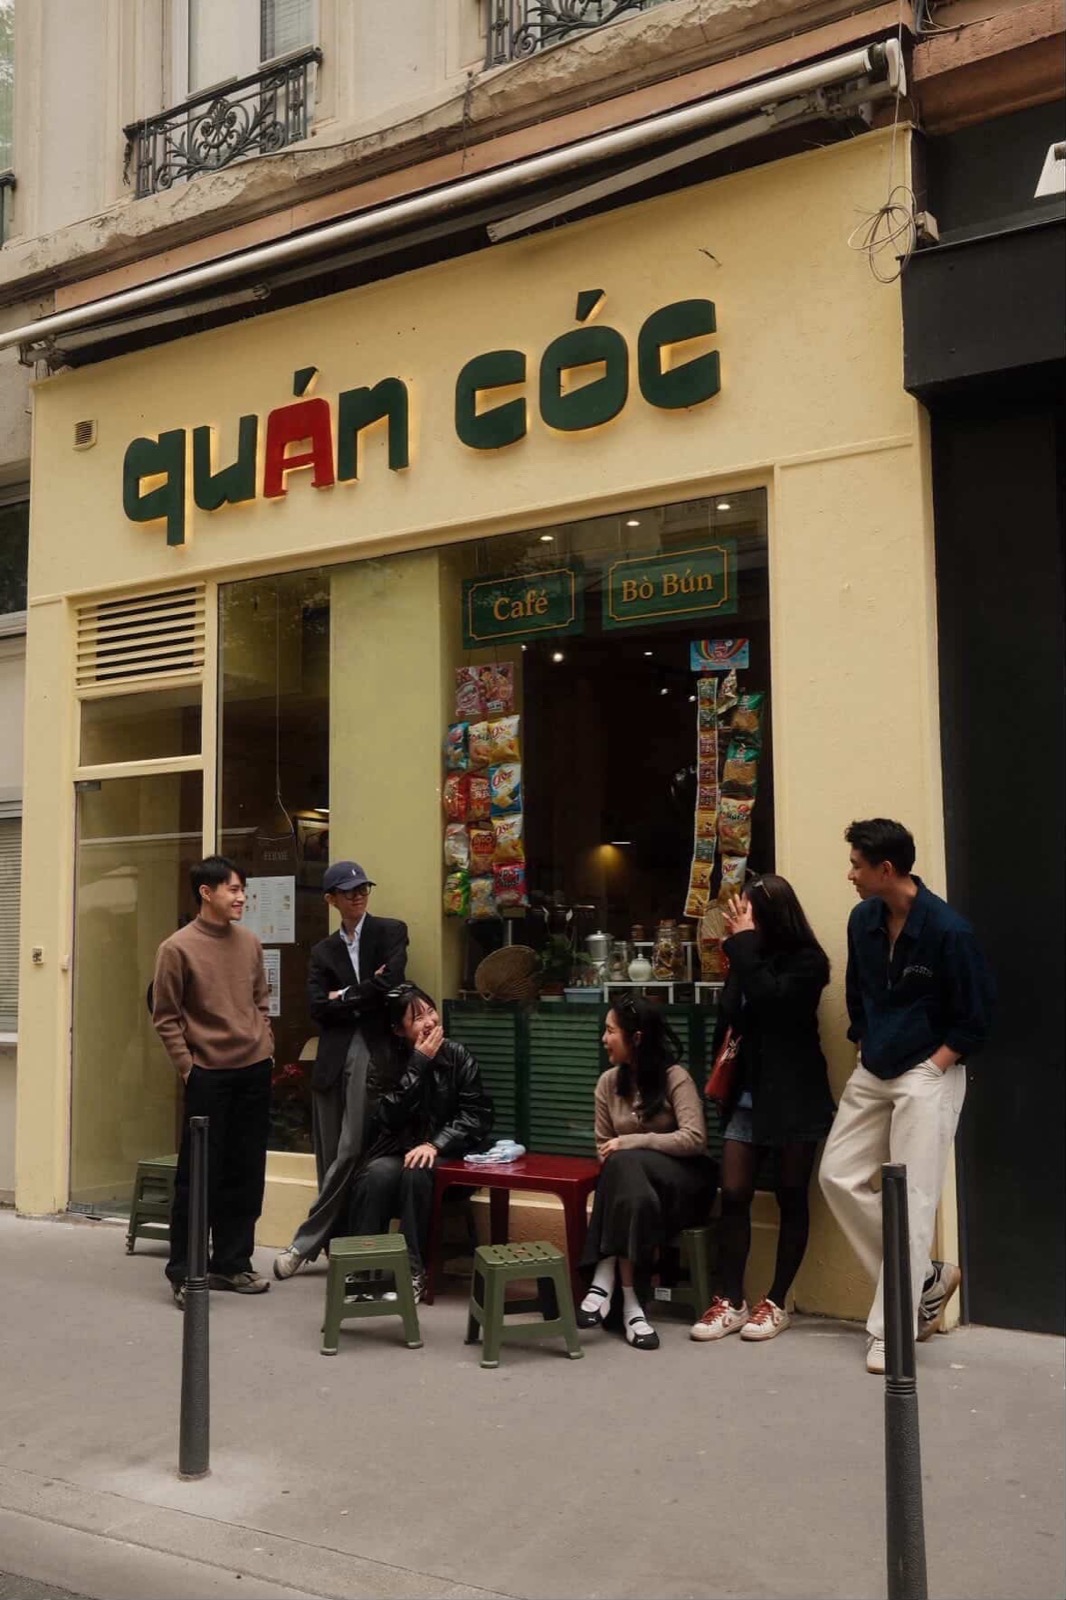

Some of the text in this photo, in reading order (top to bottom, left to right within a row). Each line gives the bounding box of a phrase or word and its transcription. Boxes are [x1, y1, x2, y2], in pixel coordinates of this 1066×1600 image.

[621, 566, 714, 603] Bò Bún
[492, 588, 550, 621] Café
